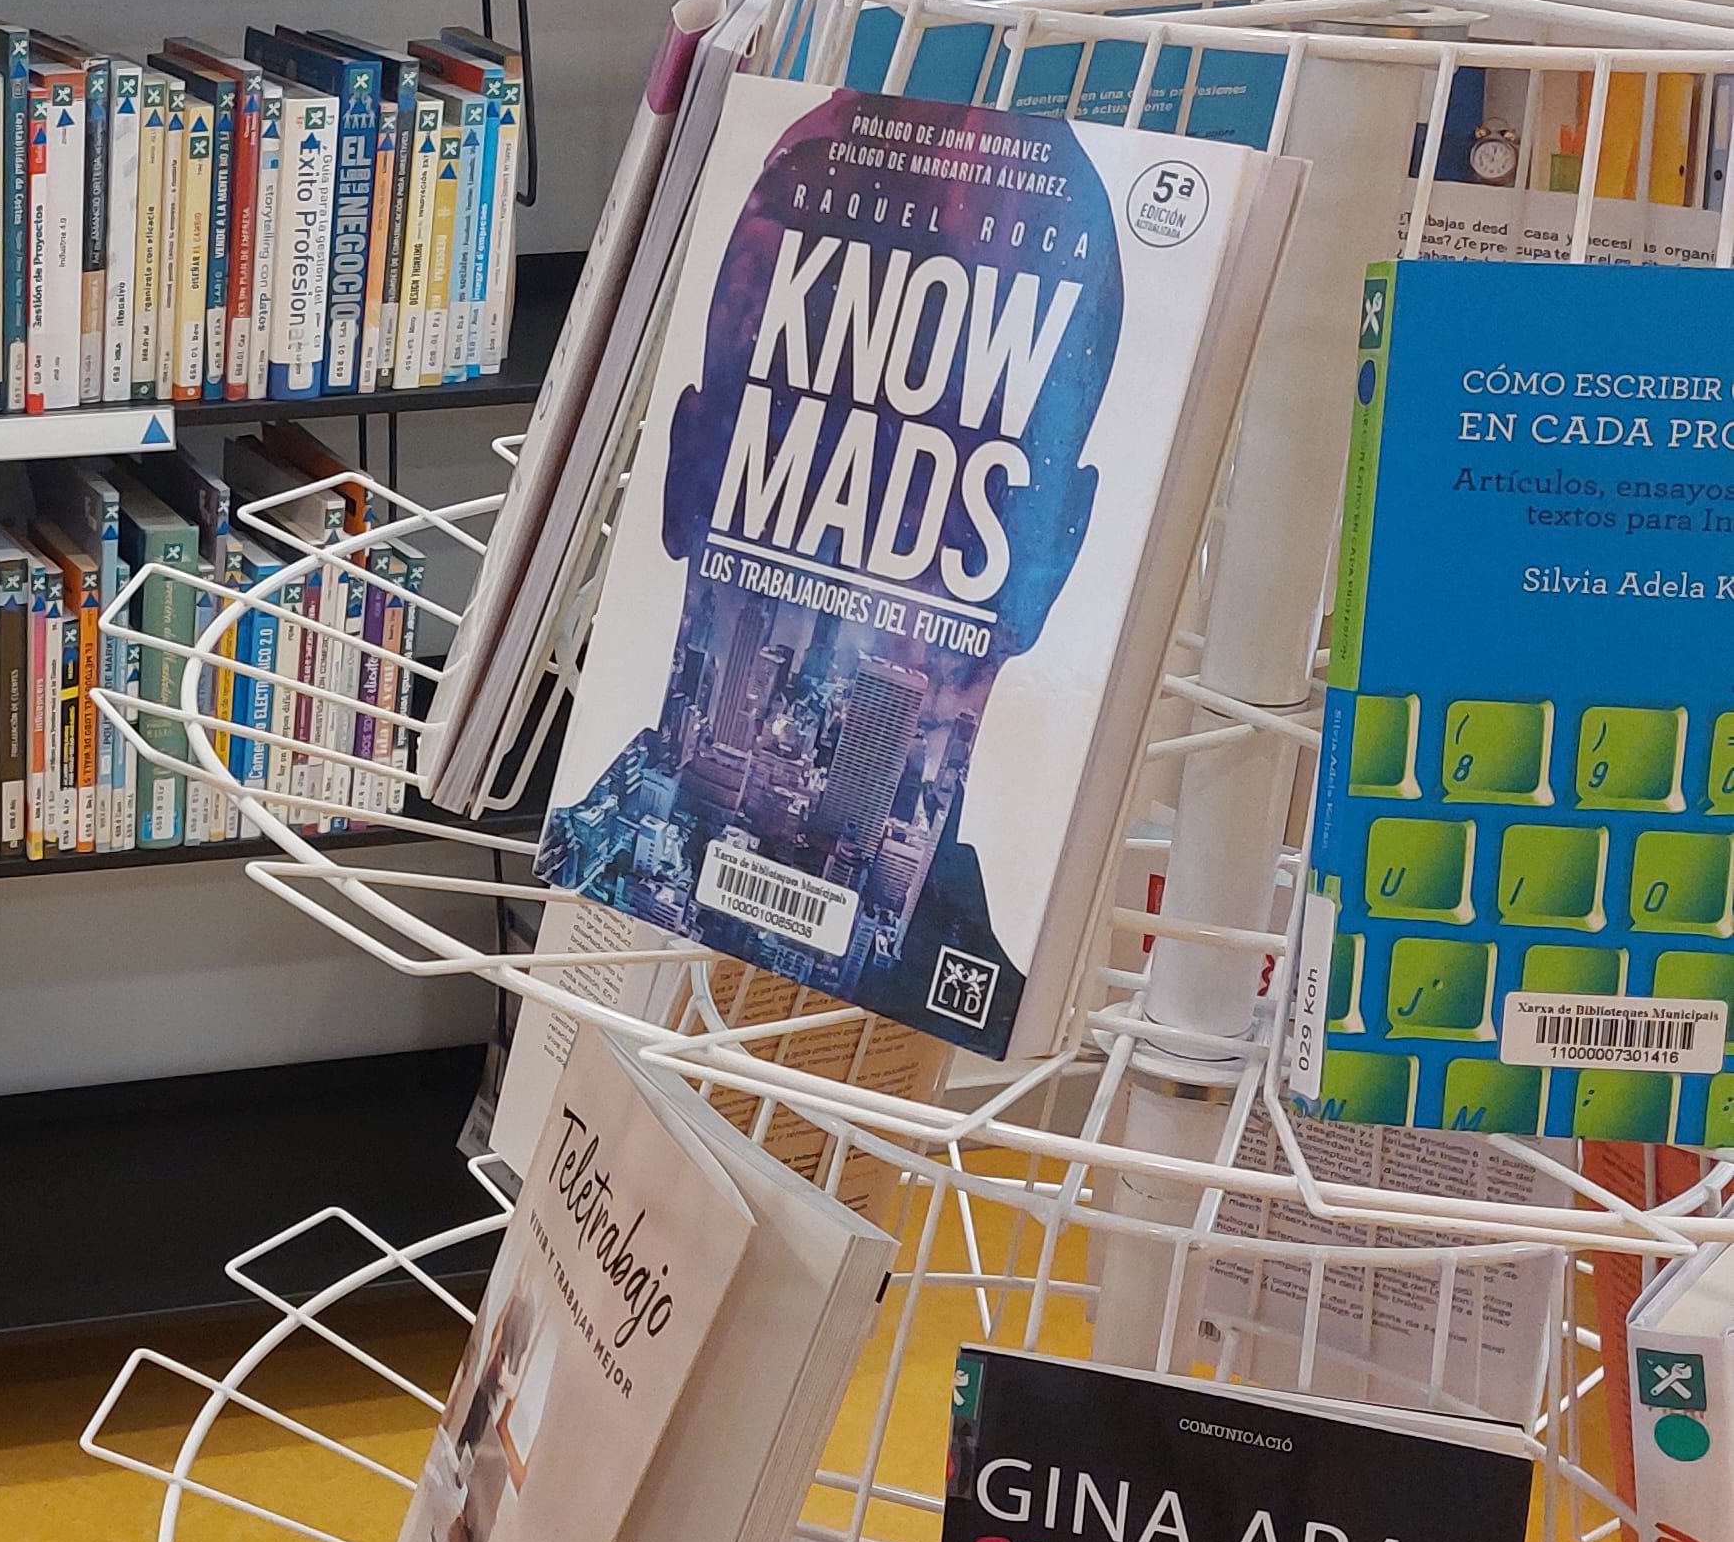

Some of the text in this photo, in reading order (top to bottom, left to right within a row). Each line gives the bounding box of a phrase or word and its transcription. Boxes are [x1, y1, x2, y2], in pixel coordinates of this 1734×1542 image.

[851, 112, 1053, 163] PRÓLOGO DE JOHN MORAVEC
[828, 141, 1069, 197] EPÍLOGO DE MARGARITA ÁLVAREZ
[792, 184, 1090, 260] RAQUEL ROCA
[748, 229, 1084, 440] KNOW
[1462, 363, 1722, 401] CÓMO ESCRIBIR
[1458, 412, 1654, 448] EN CADA
[710, 382, 1031, 604] MADS
[1453, 467, 1605, 500] Artículos,
[1527, 505, 1692, 536] textos para
[699, 548, 992, 658] LOS TRABAJADORES DEL FUTURO
[1522, 567, 1705, 599] Silvia Adela
[937, 979, 982, 1015] LID
[1298, 967, 1320, 1072] 029 Koh
[1558, 1003, 1649, 1020] de Biblioteques
[548, 1102, 674, 1349] Teletrabajo
[552, 1260, 634, 1400] TRABAJAR MEJOR
[1178, 1417, 1294, 1453] COMUNICACIÓ
